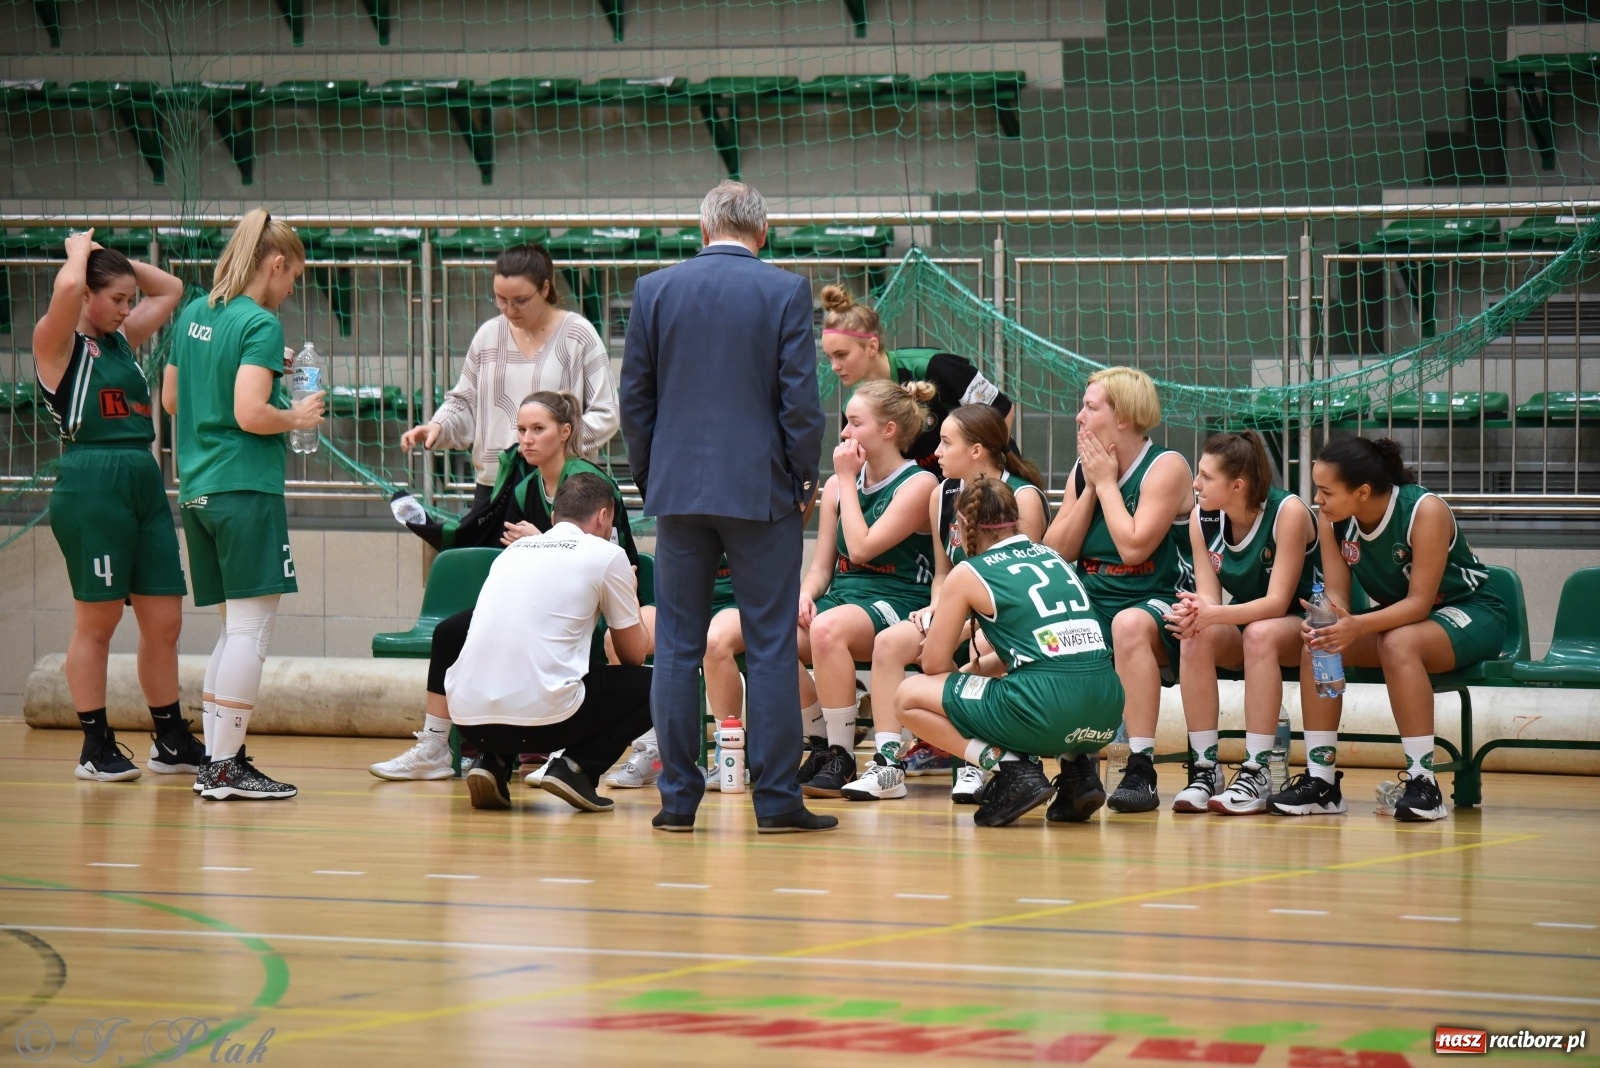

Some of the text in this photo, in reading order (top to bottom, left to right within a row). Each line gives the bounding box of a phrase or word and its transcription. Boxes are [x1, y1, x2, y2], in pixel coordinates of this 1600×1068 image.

[983, 552, 1011, 566] RKK
[94, 555, 113, 587] 4
[1006, 558, 1090, 618] 23
[727, 774, 734, 783] 3
